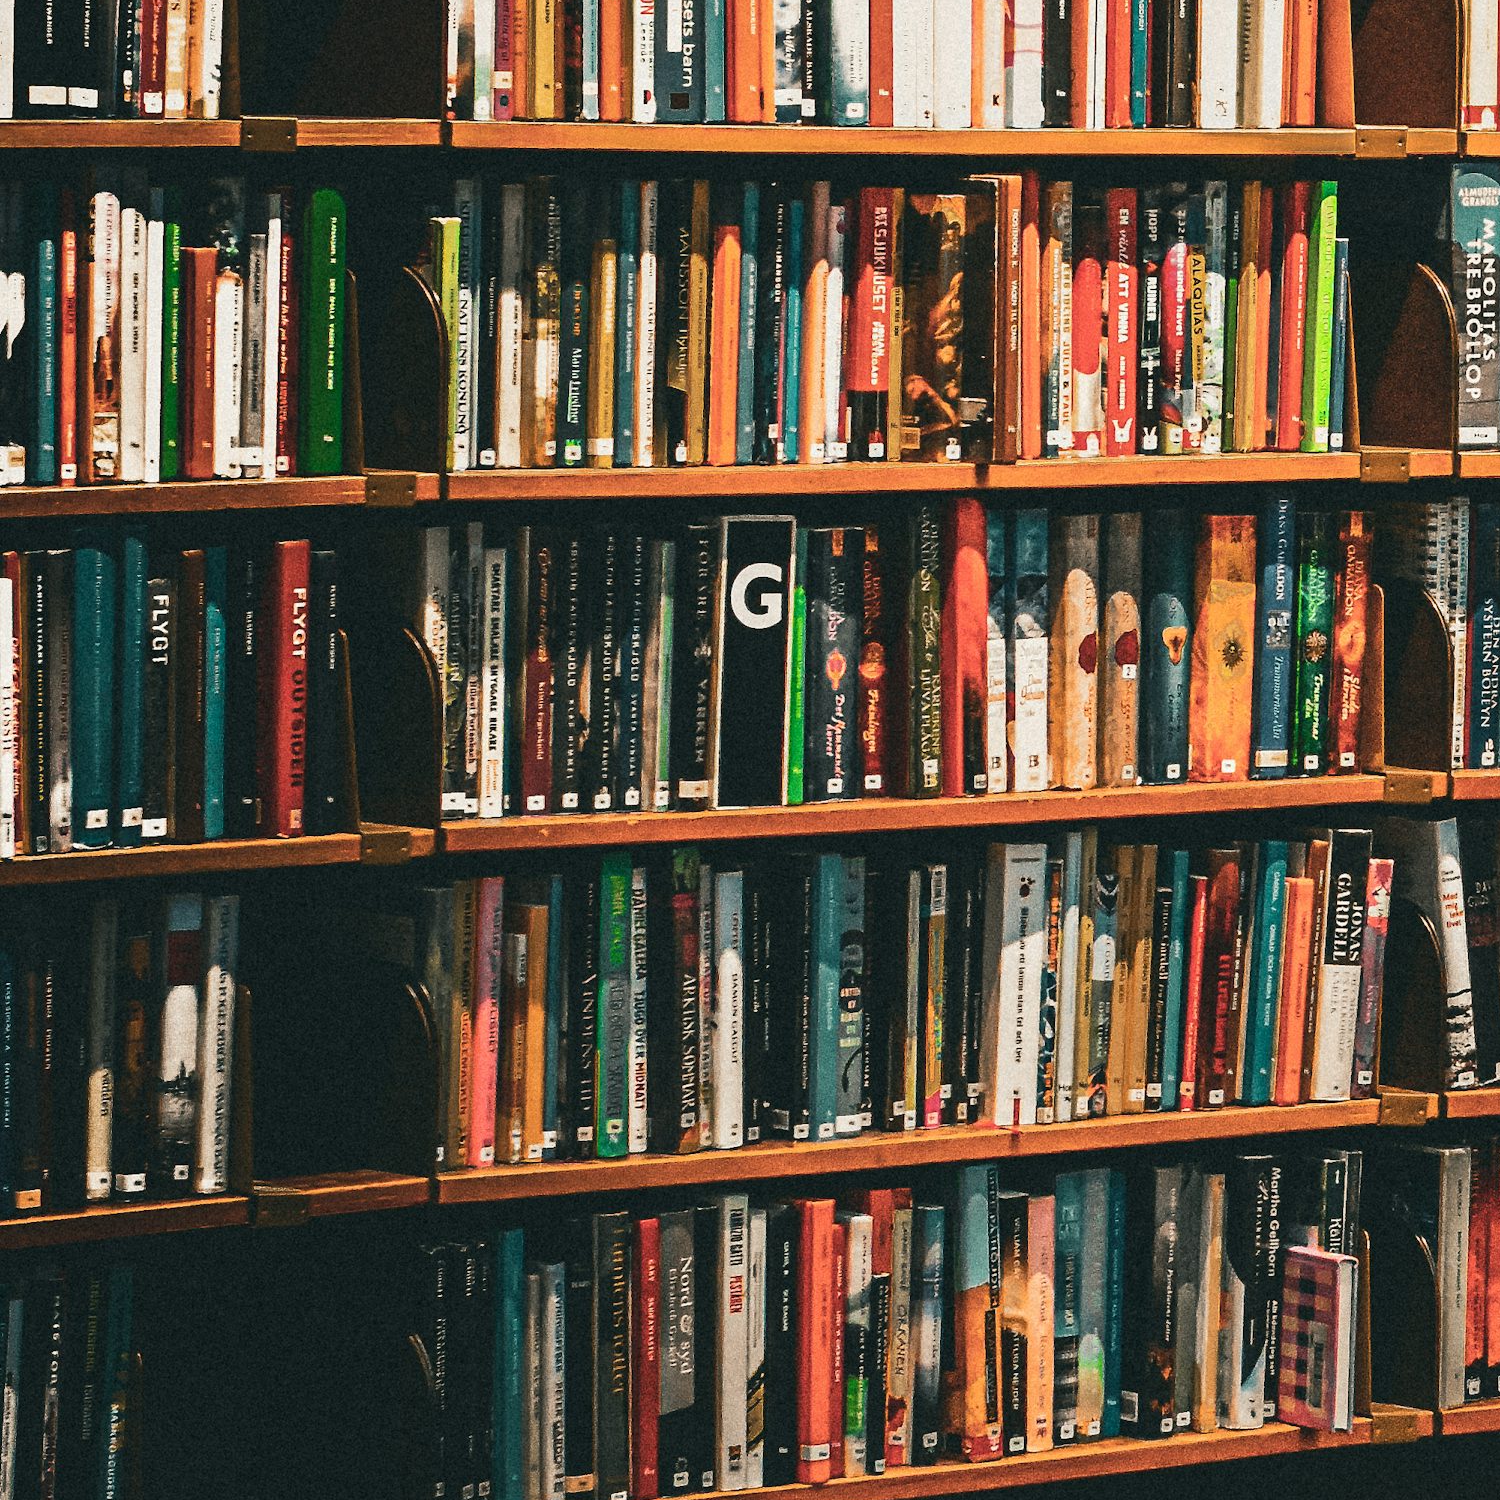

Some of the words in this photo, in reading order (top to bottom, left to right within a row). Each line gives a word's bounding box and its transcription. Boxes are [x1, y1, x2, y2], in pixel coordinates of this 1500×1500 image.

[682, 43, 695, 88] barn
[1119, 207, 1129, 226] EN
[872, 228, 886, 314] SJUKHUSET
[1118, 272, 1129, 299] ATT
[1466, 237, 1482, 280] TRE
[1482, 216, 1496, 362] MANOLITAS
[1118, 301, 1129, 344] VINNA
[1146, 276, 1157, 323] RUINER
[1465, 287, 1486, 401] BRÖLLOP
[729, 561, 784, 629] G
[1275, 538, 1287, 601] GABALDON
[152, 594, 170, 667] FLYGT
[292, 586, 306, 661] FLYGT
[1481, 667, 1493, 729] BOLEYN
[1332, 872, 1350, 962] GARDELL
[1349, 900, 1364, 963] JONAS
[1269, 1166, 1282, 1218] Martha
[1267, 1218, 1280, 1278] Gellhorn
[680, 1255, 693, 1308] Nord
[679, 1340, 693, 1376] syd
